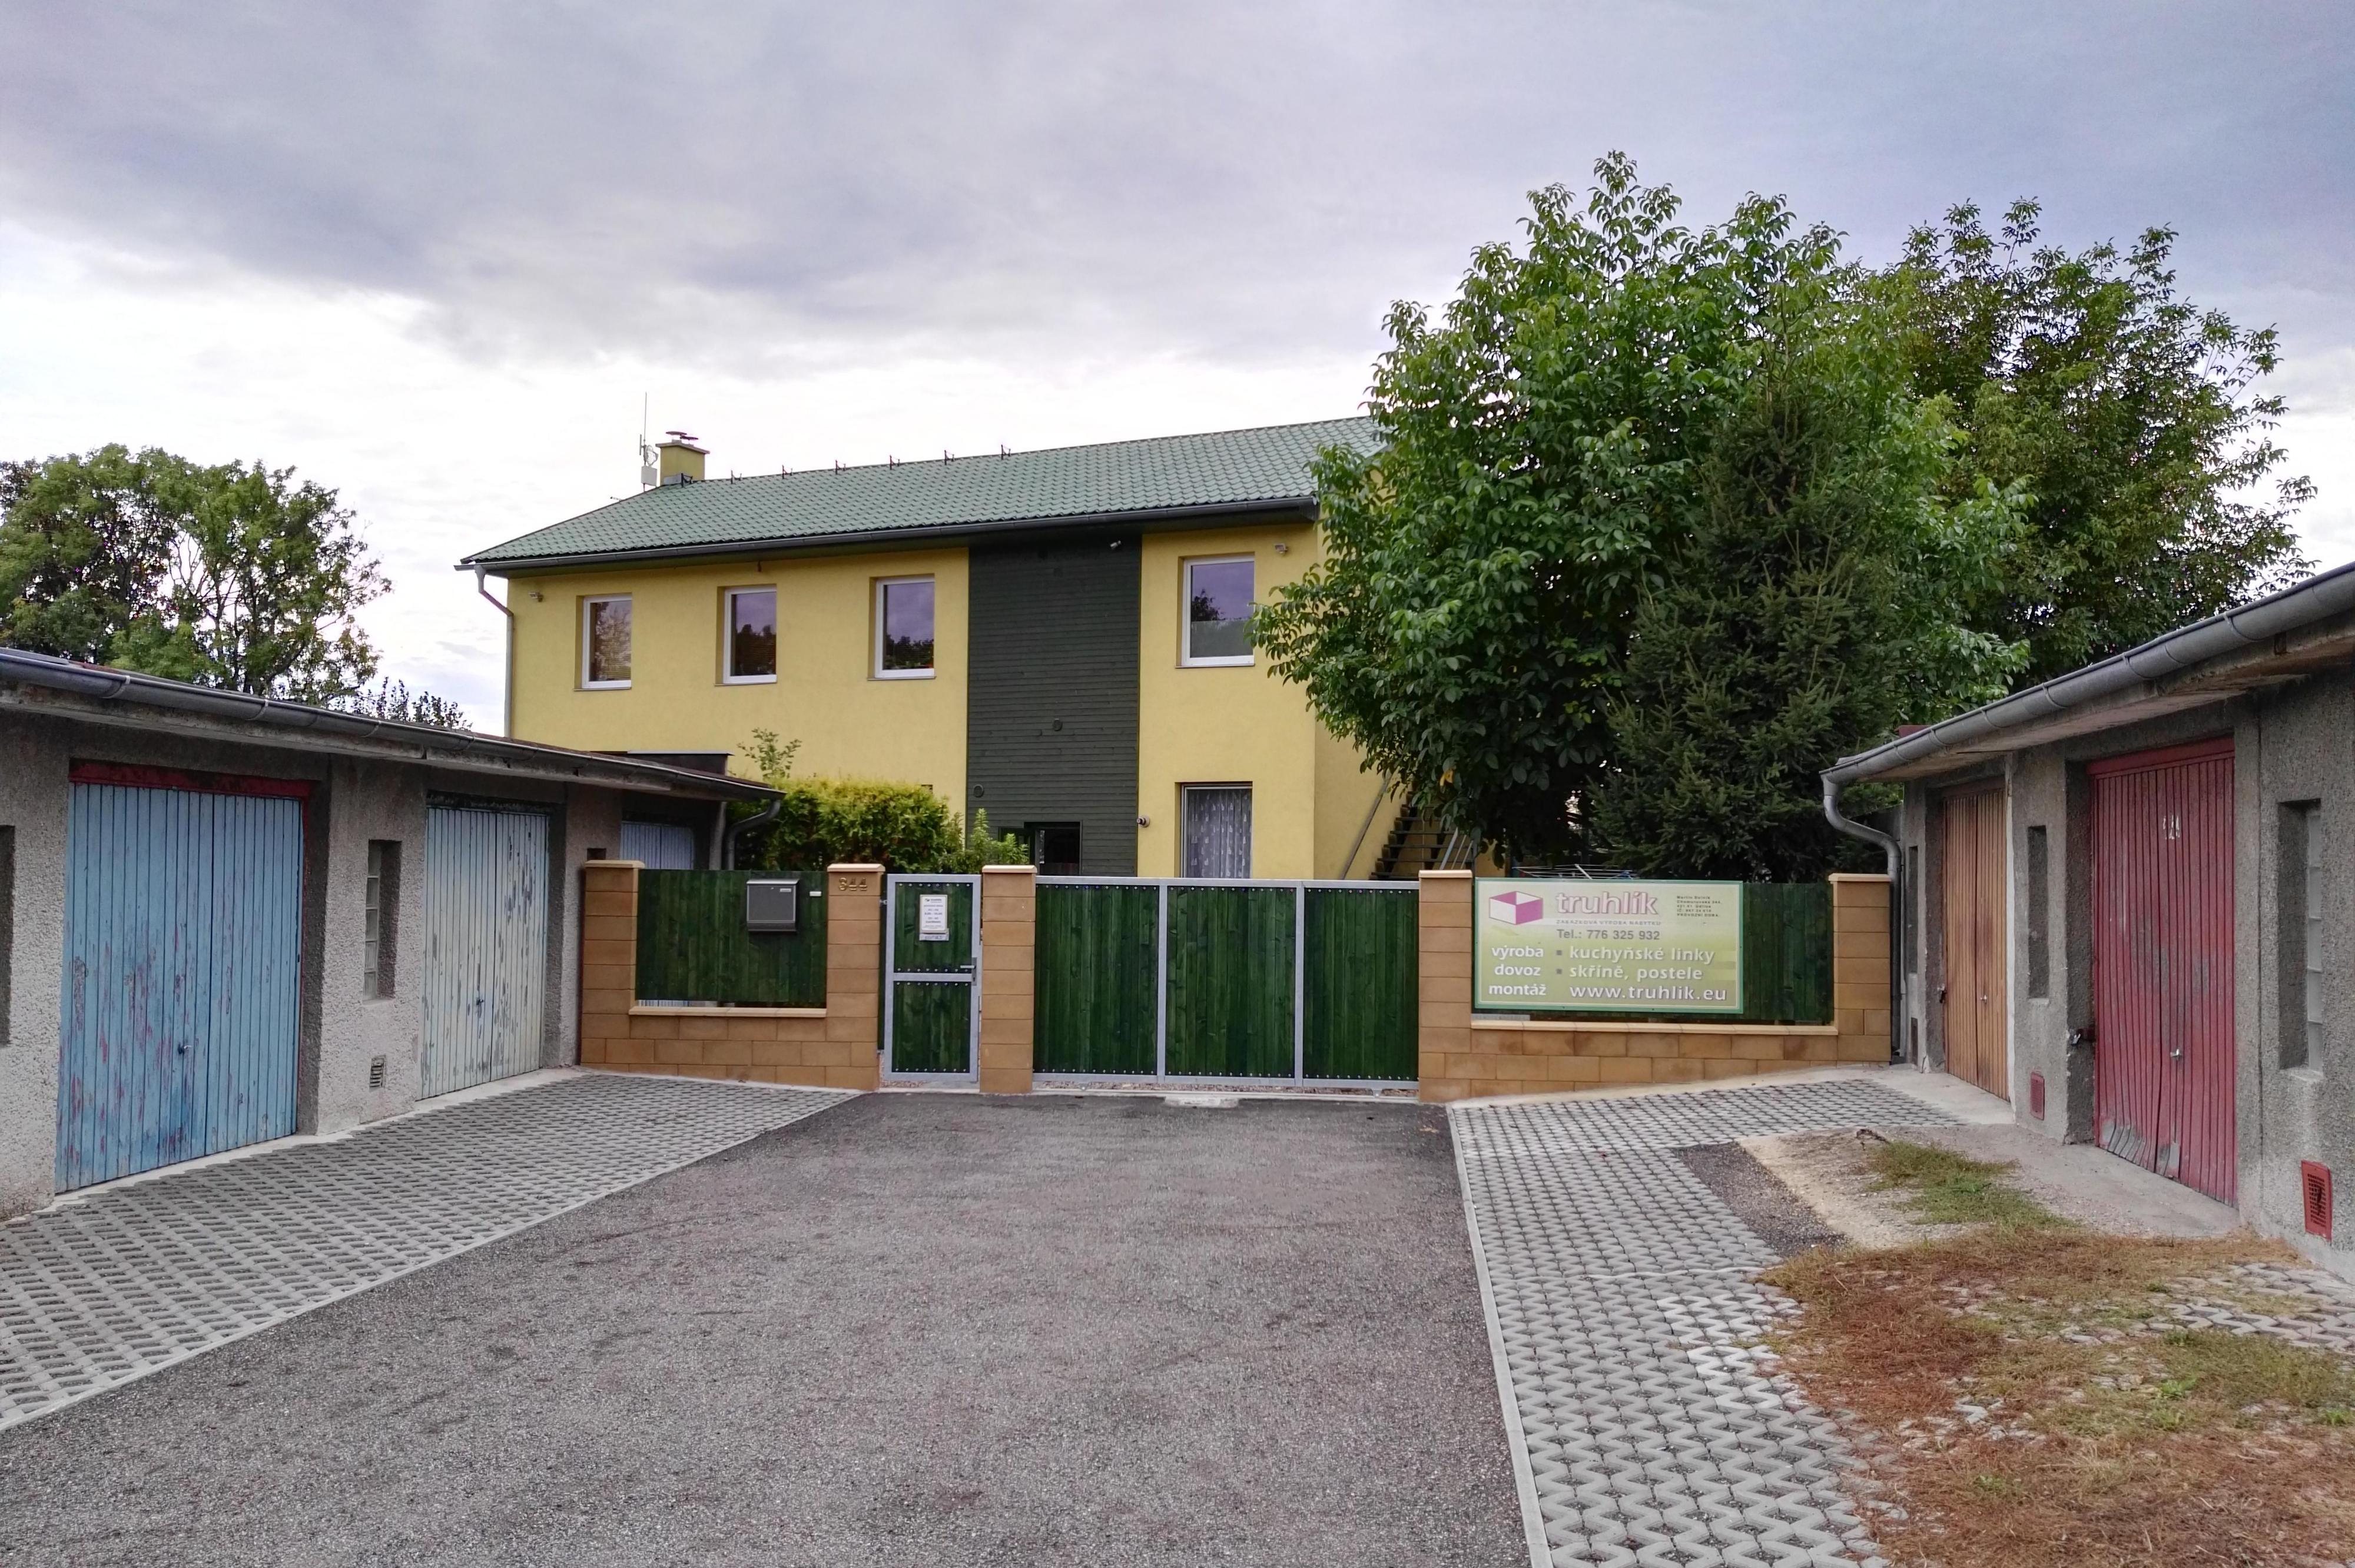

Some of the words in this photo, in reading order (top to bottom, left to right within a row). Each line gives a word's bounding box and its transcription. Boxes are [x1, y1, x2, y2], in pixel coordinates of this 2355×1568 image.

[839, 877, 867, 891] 344
[1555, 891, 1659, 915] truhlík
[1556, 929, 1582, 939] Tel.:
[1587, 929, 1608, 939] 776
[1613, 930, 1634, 939] 325
[1638, 931, 1660, 940] 932
[1491, 945, 1544, 960] výroba
[1570, 946, 1664, 963] kuchyňské
[1671, 948, 1715, 965] linky
[1494, 964, 1541, 976] dovoz
[1570, 965, 1629, 980] skříně,
[1637, 967, 1703, 982] postele
[1488, 984, 1547, 996] montáž
[1570, 985, 1727, 1001] www.truhlik.eu
